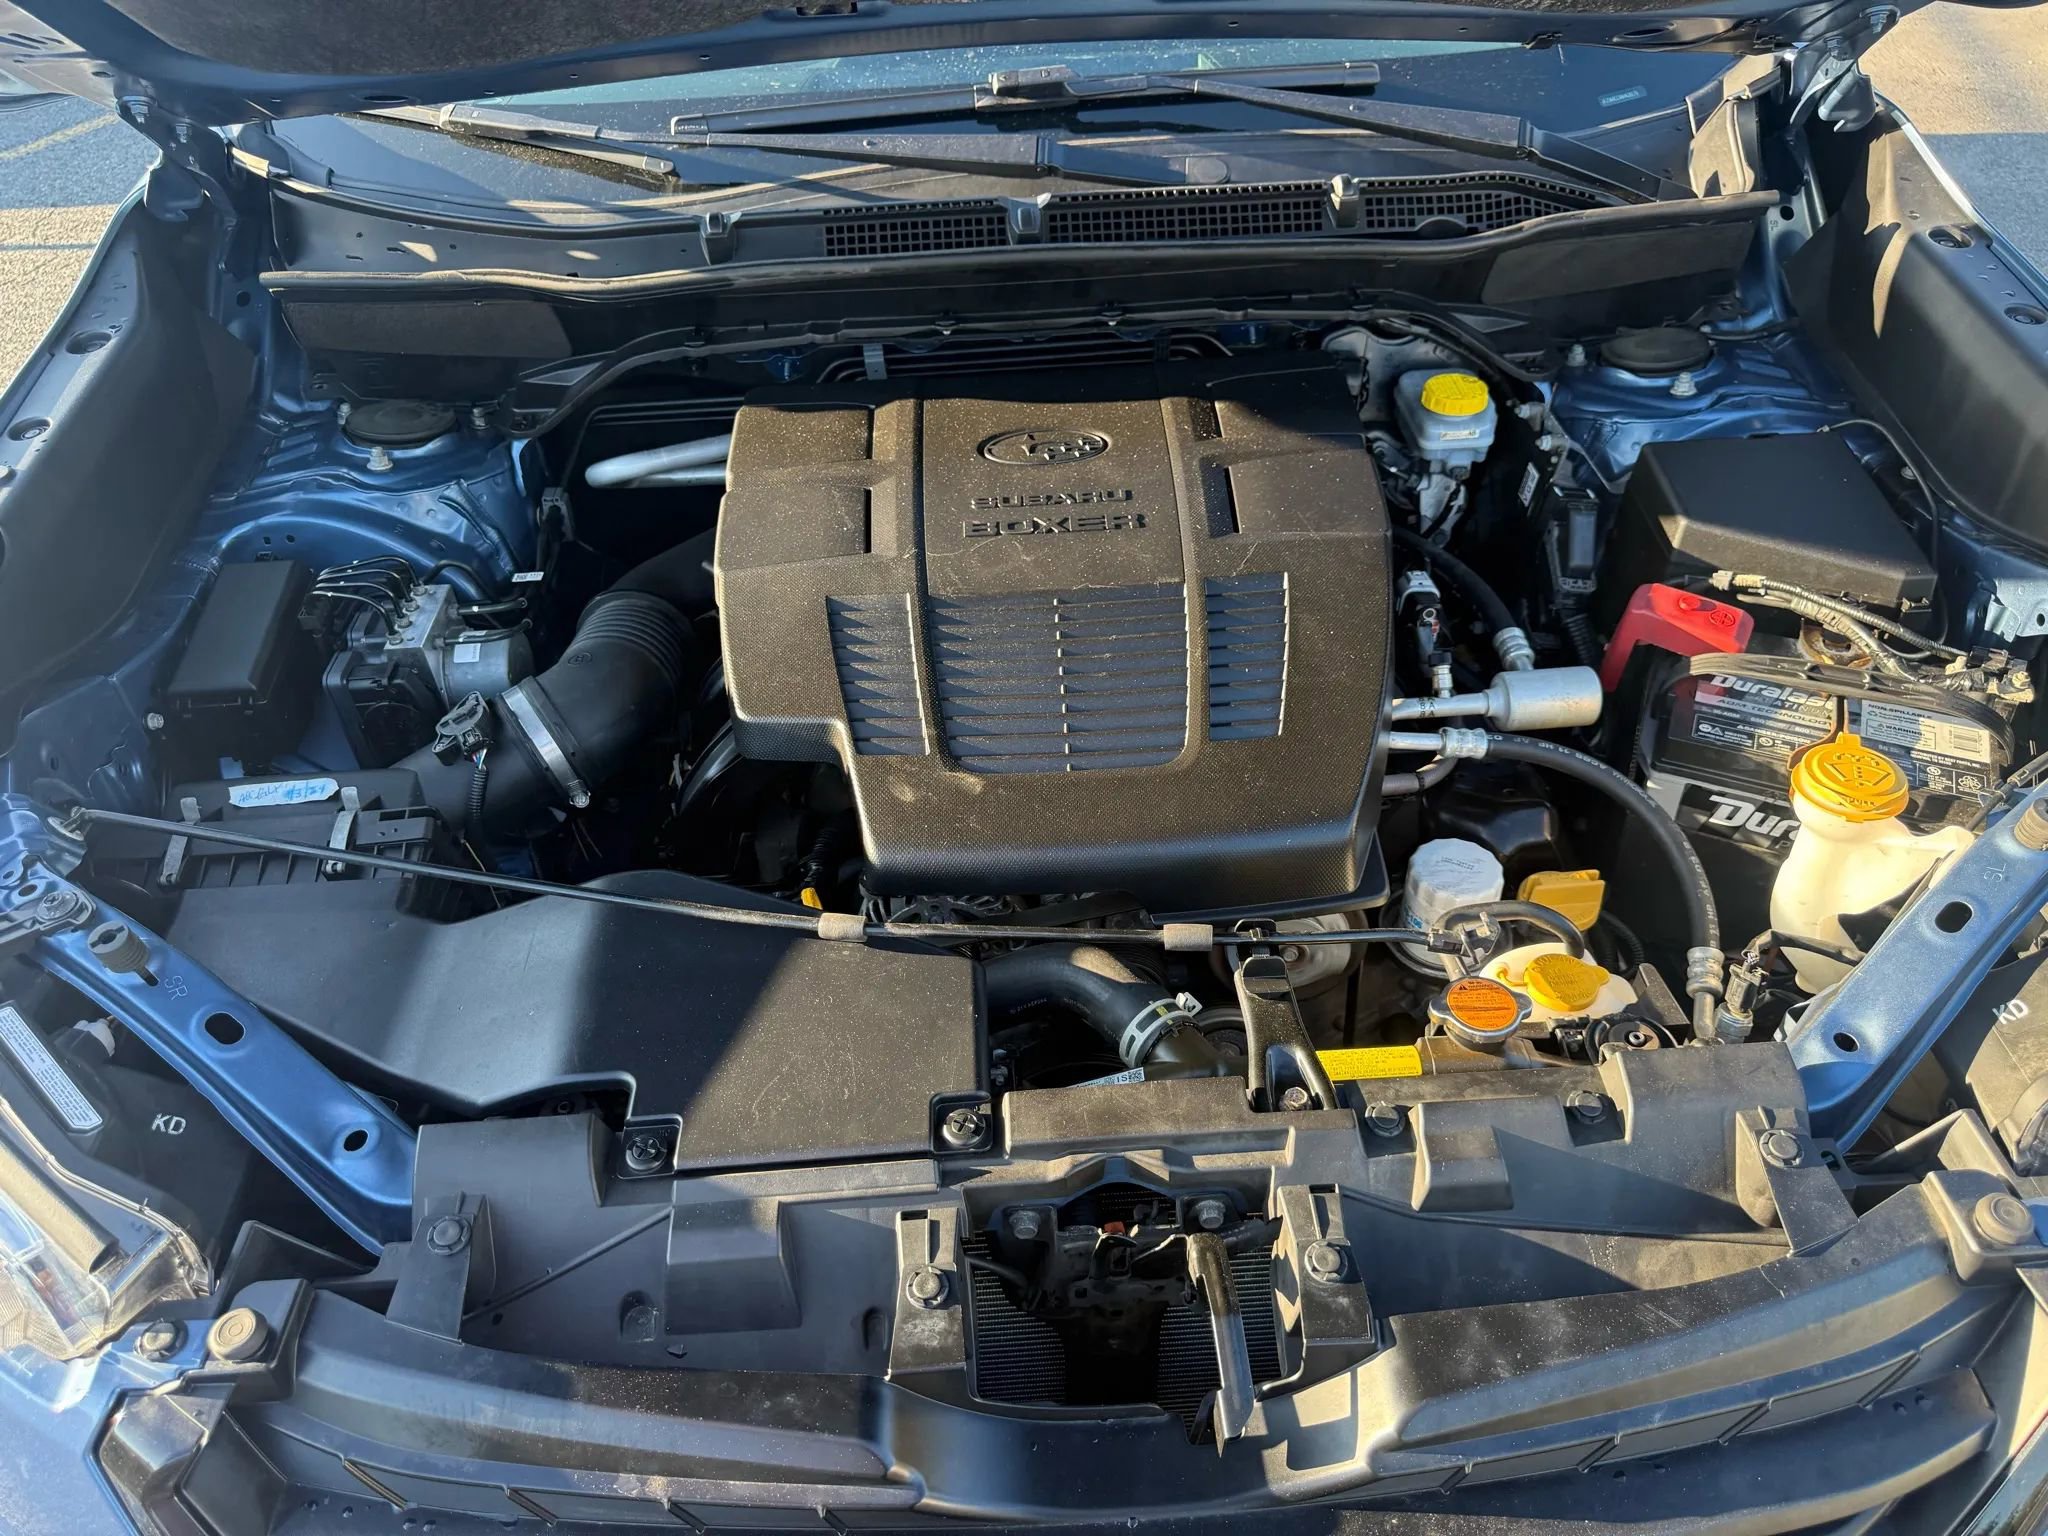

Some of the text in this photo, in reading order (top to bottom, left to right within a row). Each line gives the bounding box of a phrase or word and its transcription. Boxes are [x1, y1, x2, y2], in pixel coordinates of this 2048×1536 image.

[970, 489, 1133, 508] SUBARU
[962, 513, 1147, 537] BOXER
[1710, 674, 1833, 709] Duralast
[164, 975, 189, 1001] SR
[1991, 999, 2030, 1025] KD
[151, 1112, 187, 1135] KD
